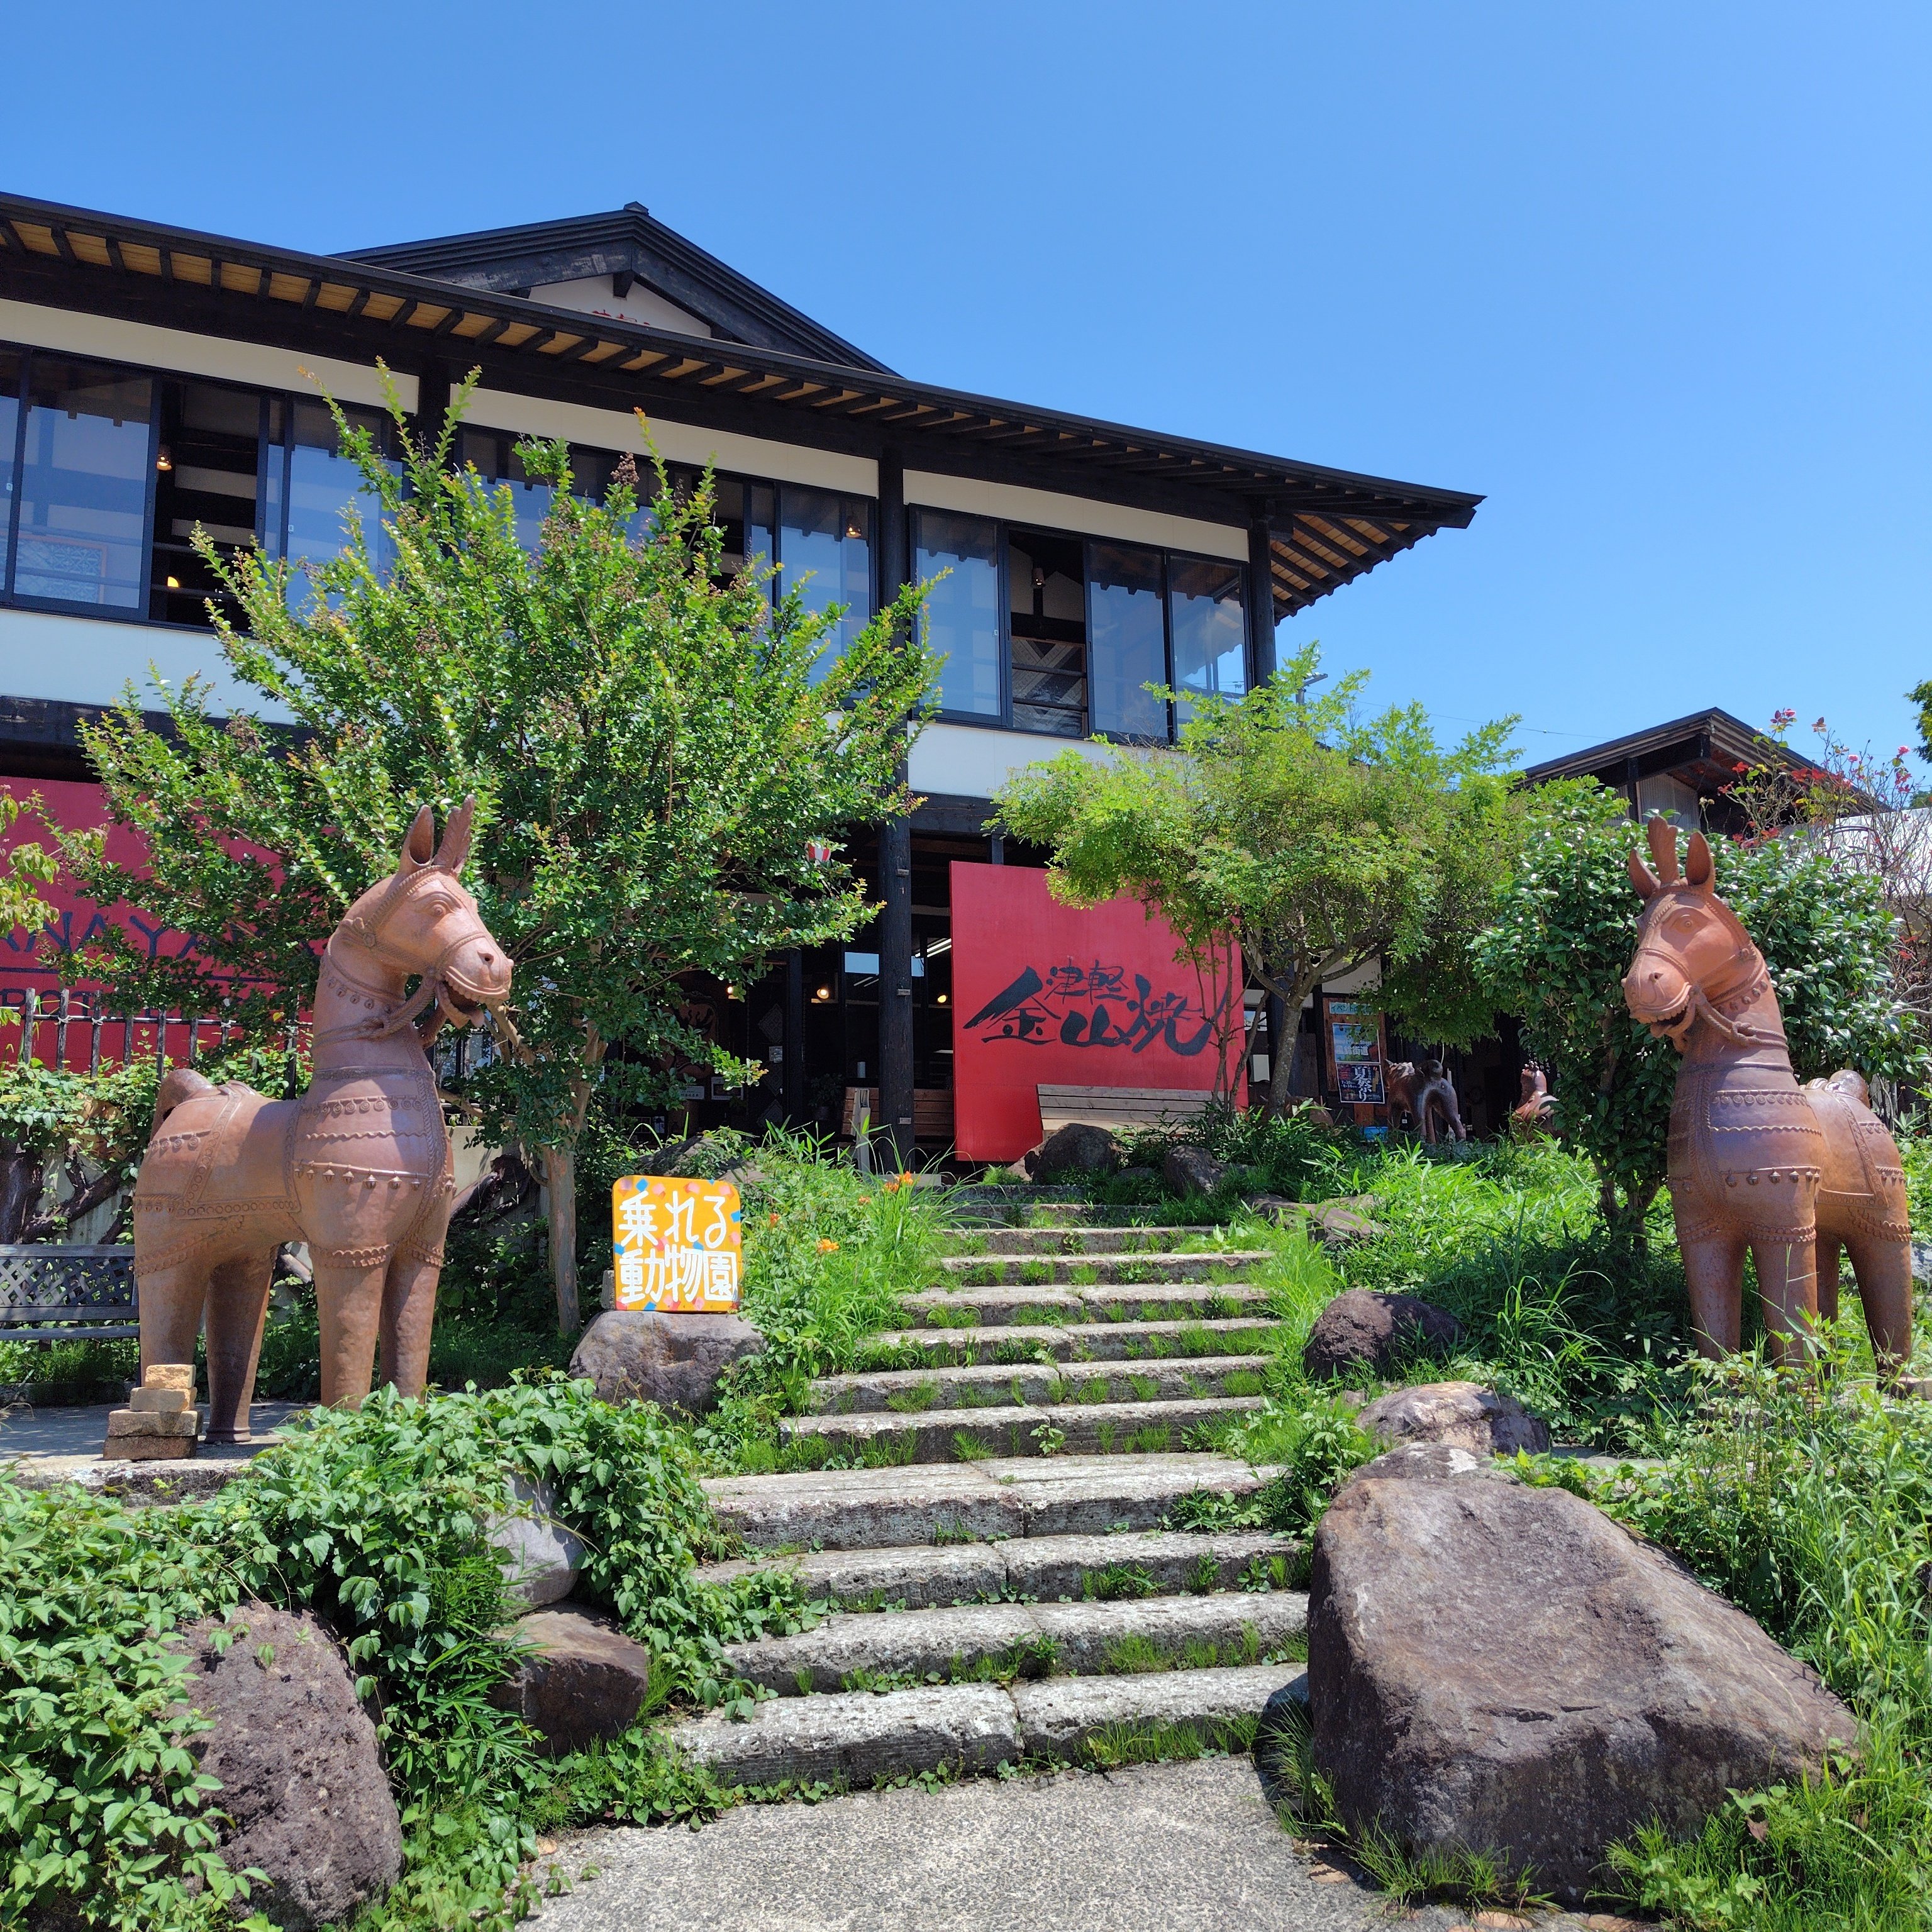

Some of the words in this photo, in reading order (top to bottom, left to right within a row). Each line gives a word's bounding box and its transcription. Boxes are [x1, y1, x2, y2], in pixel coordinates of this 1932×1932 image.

[963, 965, 1230, 1057] 金山焼
[1043, 958, 1130, 1006] 津軽
[1352, 1065, 1372, 1102] 夏祭り
[618, 1190, 727, 1249] 乗れる
[619, 1244, 738, 1304] 動物園
